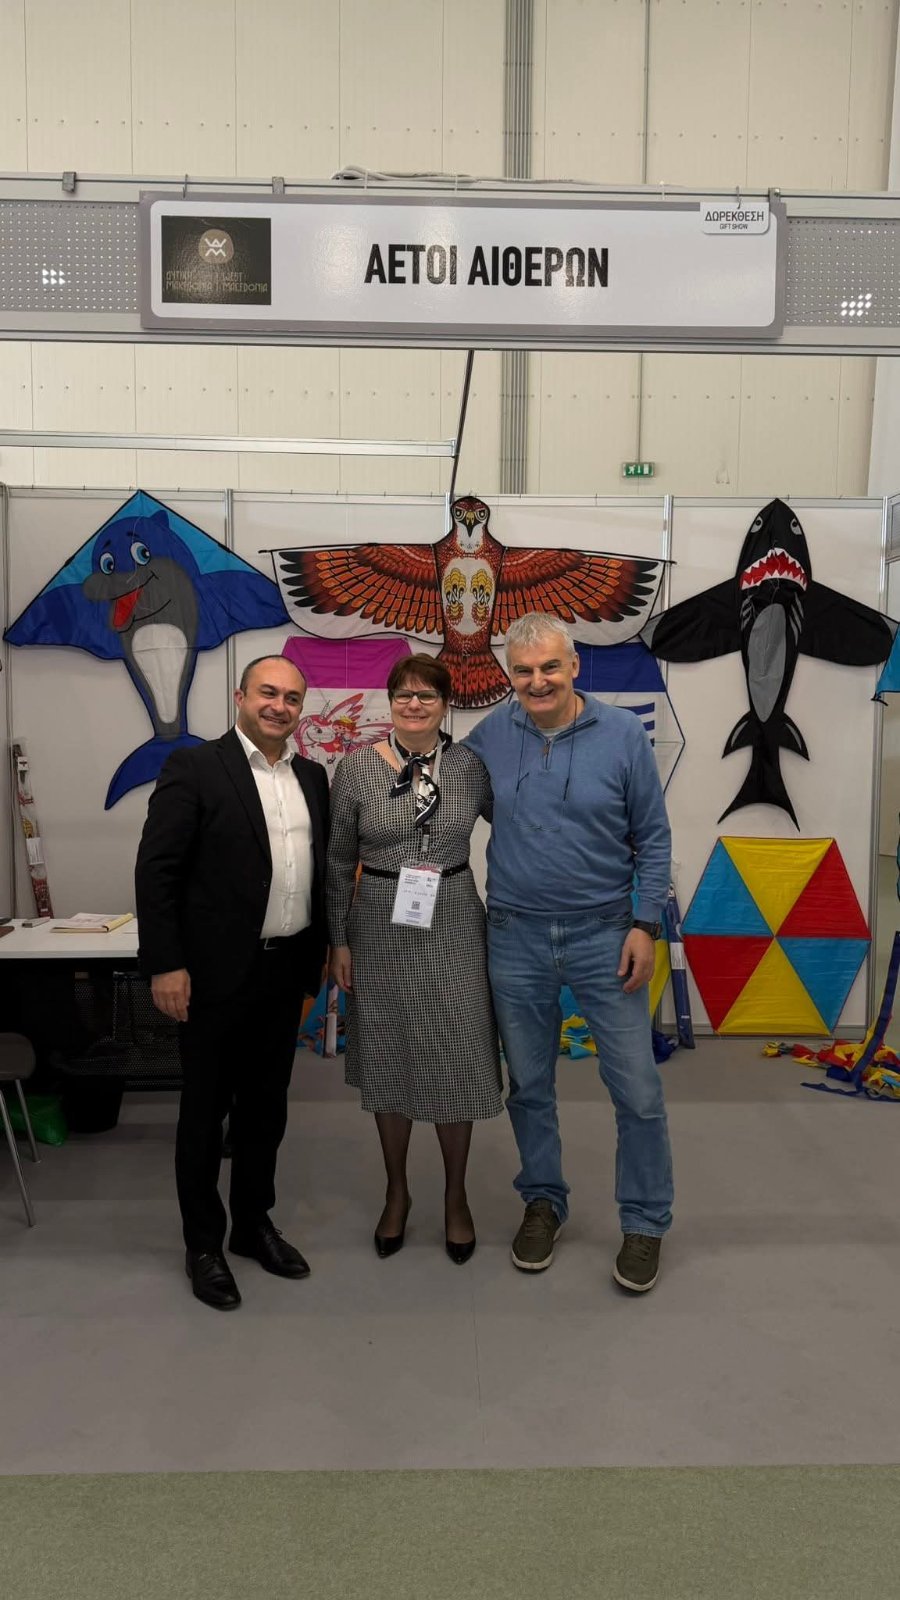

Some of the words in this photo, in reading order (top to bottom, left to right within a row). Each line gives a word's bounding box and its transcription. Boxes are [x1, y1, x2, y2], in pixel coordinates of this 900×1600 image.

[705, 211, 764, 222] ΔΩΡΕΚΘΕΣΗ
[364, 243, 457, 285] ΑΕΤΟΙ
[467, 245, 608, 288] ΑΙΘΕΡΩΝ
